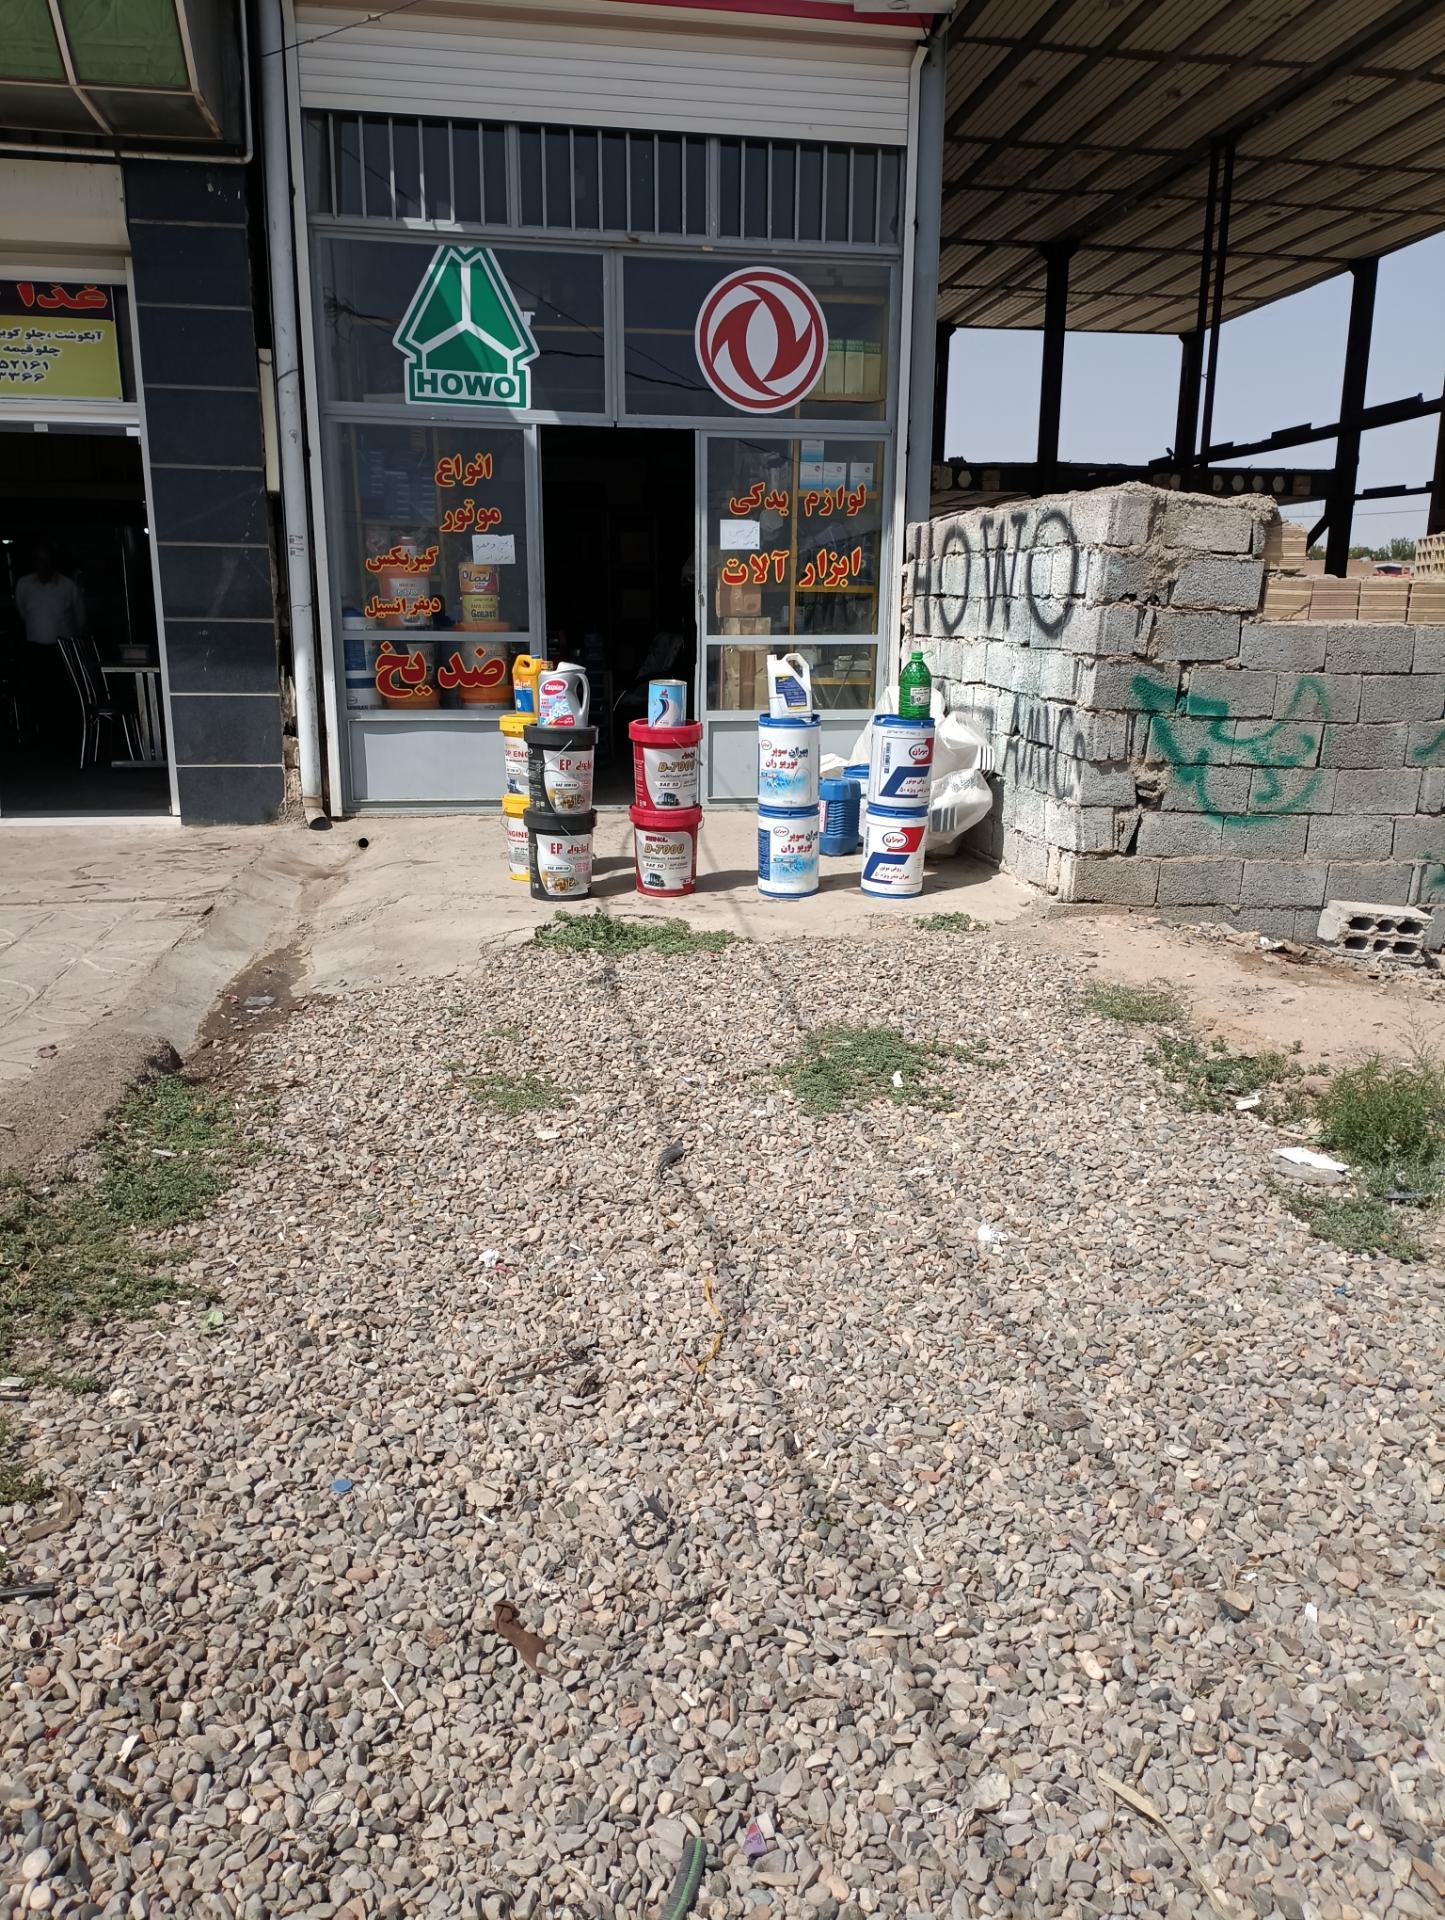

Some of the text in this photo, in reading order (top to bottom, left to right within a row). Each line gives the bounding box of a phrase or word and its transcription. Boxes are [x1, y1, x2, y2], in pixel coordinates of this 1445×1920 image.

[417, 372, 517, 399] HOWO
[434, 452, 493, 488] انواع
[439, 498, 502, 533] موتور
[729, 482, 867, 517] لوازم یدکی
[721, 546, 862, 588] ابزار آلات
[912, 510, 1078, 638] HOWO
[375, 640, 506, 699] ضد یخ
[559, 759, 572, 771] EP
[550, 843, 563, 855] EP
